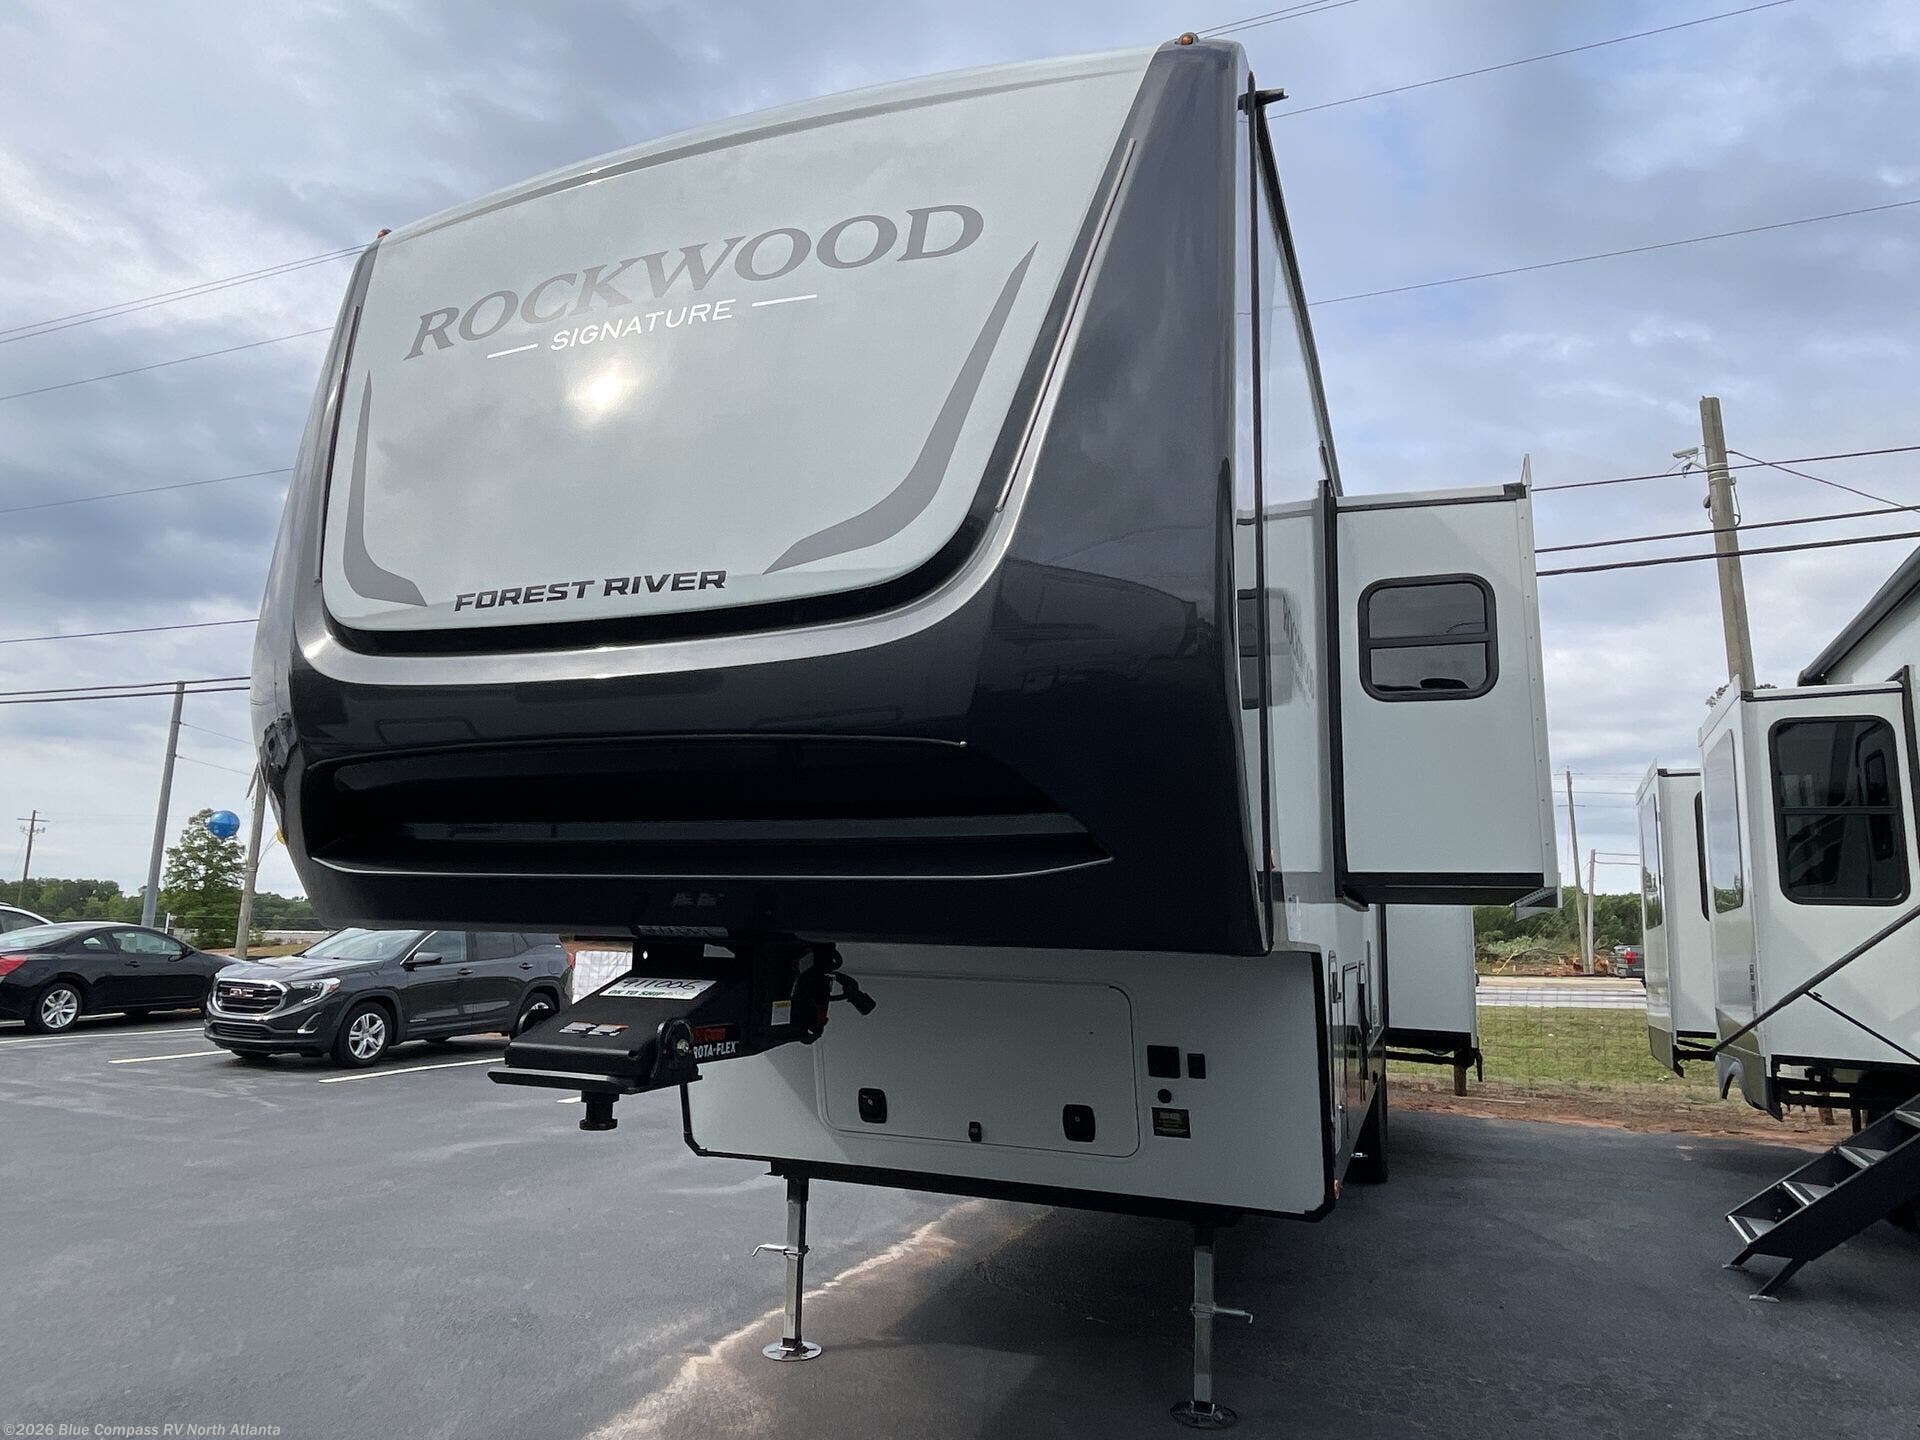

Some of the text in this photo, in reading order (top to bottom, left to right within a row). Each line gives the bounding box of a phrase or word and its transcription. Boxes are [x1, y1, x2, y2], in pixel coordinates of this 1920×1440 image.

[403, 205, 984, 361] ROCKWOOD
[550, 299, 737, 351] SIGNATURE
[454, 570, 727, 611] FOREST RIVER
[693, 1041, 737, 1059] ROTA-FLEX
